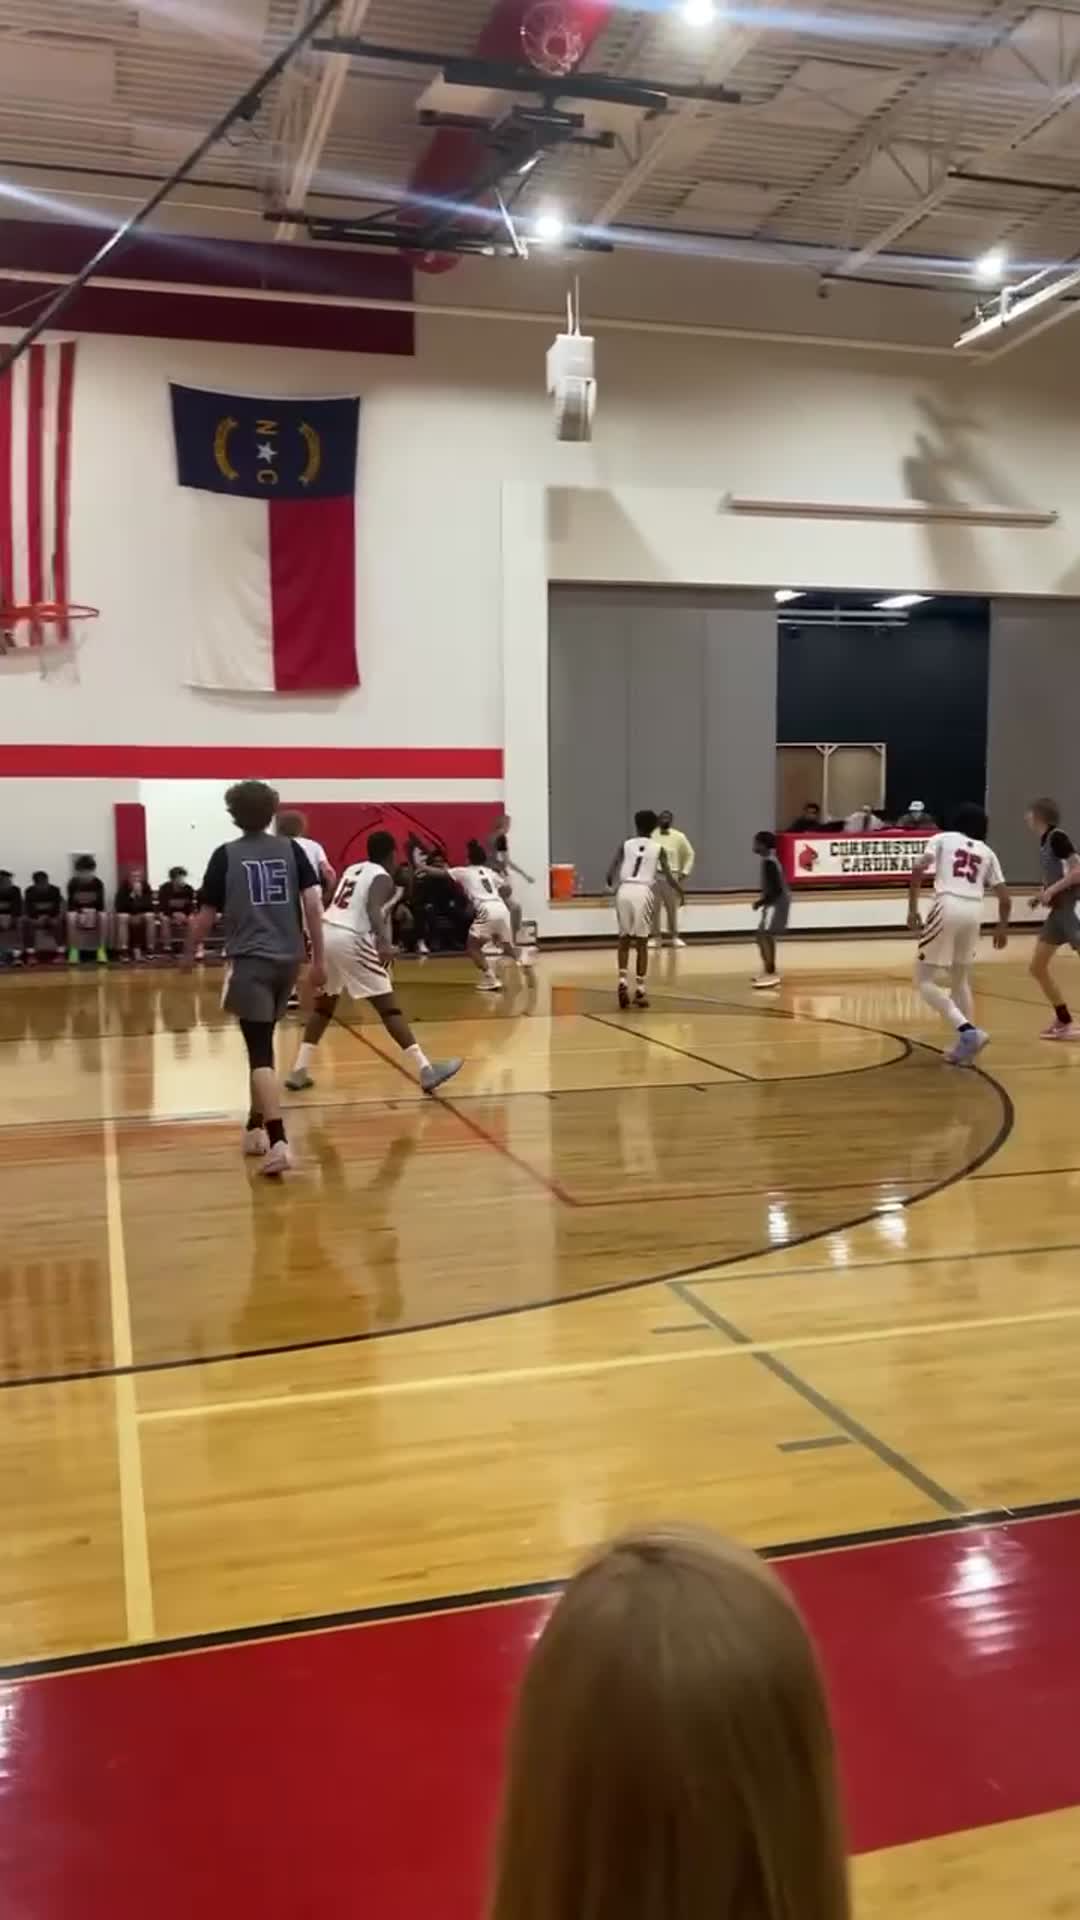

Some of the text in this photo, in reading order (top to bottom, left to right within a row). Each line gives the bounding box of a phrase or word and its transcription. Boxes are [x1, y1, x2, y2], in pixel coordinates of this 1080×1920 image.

[256, 420, 278, 485] N C
[242, 858, 289, 905] 15
[631, 856, 643, 877] 1
[953, 848, 982, 883] 25
